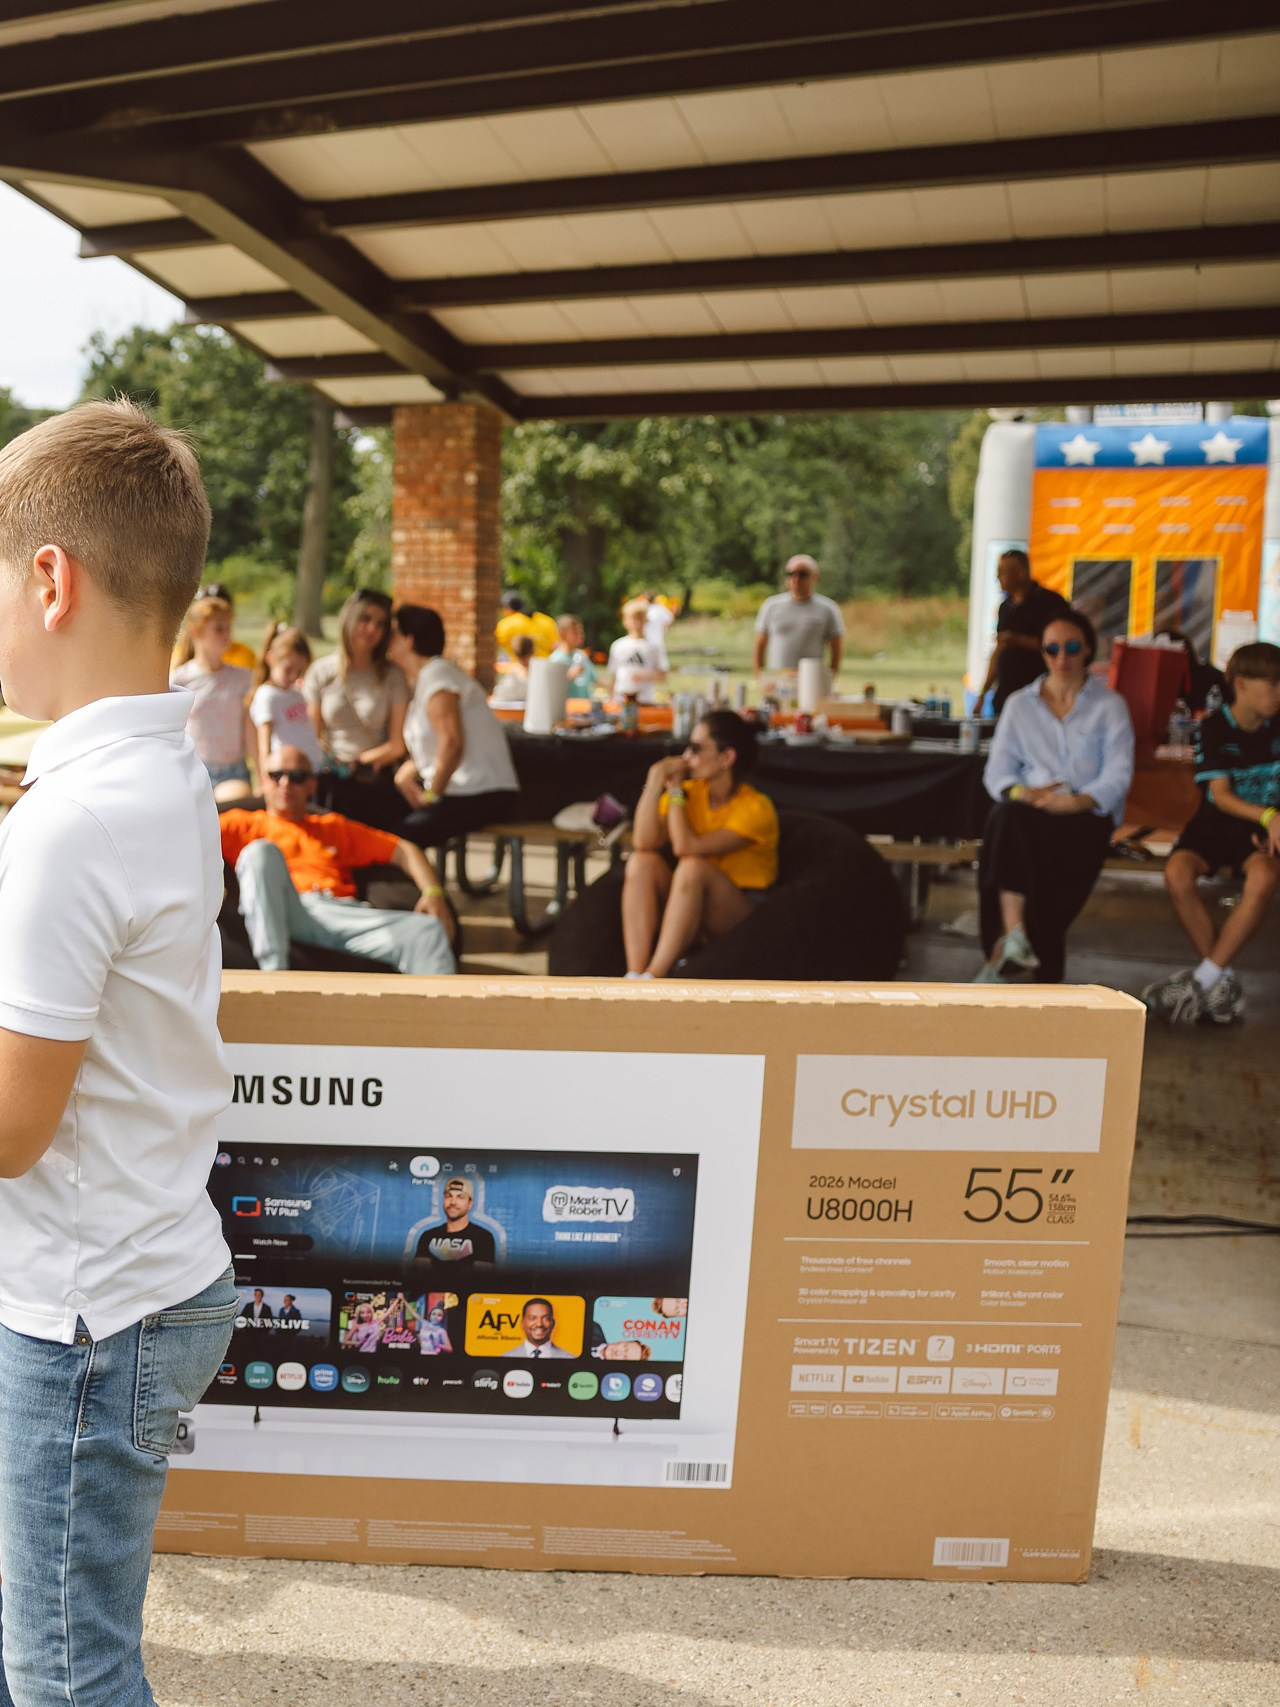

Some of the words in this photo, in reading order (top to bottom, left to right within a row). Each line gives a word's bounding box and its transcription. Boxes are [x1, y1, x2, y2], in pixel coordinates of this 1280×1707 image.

[232, 1074, 383, 1107] MSUNG
[841, 1088, 976, 1127] Crystal
[986, 1090, 1057, 1119] UHD
[809, 1175, 844, 1188] 2026
[848, 1176, 897, 1190] Model
[264, 1197, 312, 1210] Samsung
[569, 1195, 598, 1206] Mark
[603, 1198, 629, 1216] TV
[265, 1207, 277, 1216] TV
[279, 1207, 299, 1217] Plus
[569, 1206, 603, 1216] Rober
[807, 1197, 913, 1222] U8000H
[1047, 1215, 1075, 1225] CLASS
[801, 1256, 845, 1265] Thousands
[247, 1317, 280, 1329] NEWS
[281, 1319, 310, 1330] LIVE
[479, 1310, 520, 1331] AFV
[623, 1319, 681, 1331] CONAN
[382, 1327, 417, 1344] Barbie
[794, 1336, 825, 1346] Smart
[827, 1337, 840, 1346] TV
[793, 1346, 829, 1355] Powered
[844, 1338, 916, 1356] TIZEN
[937, 1338, 946, 1352] 7
[966, 1343, 973, 1353] 3
[1027, 1344, 1062, 1354] PORTS
[474, 1377, 498, 1390] sling
[798, 1373, 835, 1384] NETFLIX
[907, 1375, 943, 1385] ESPN
